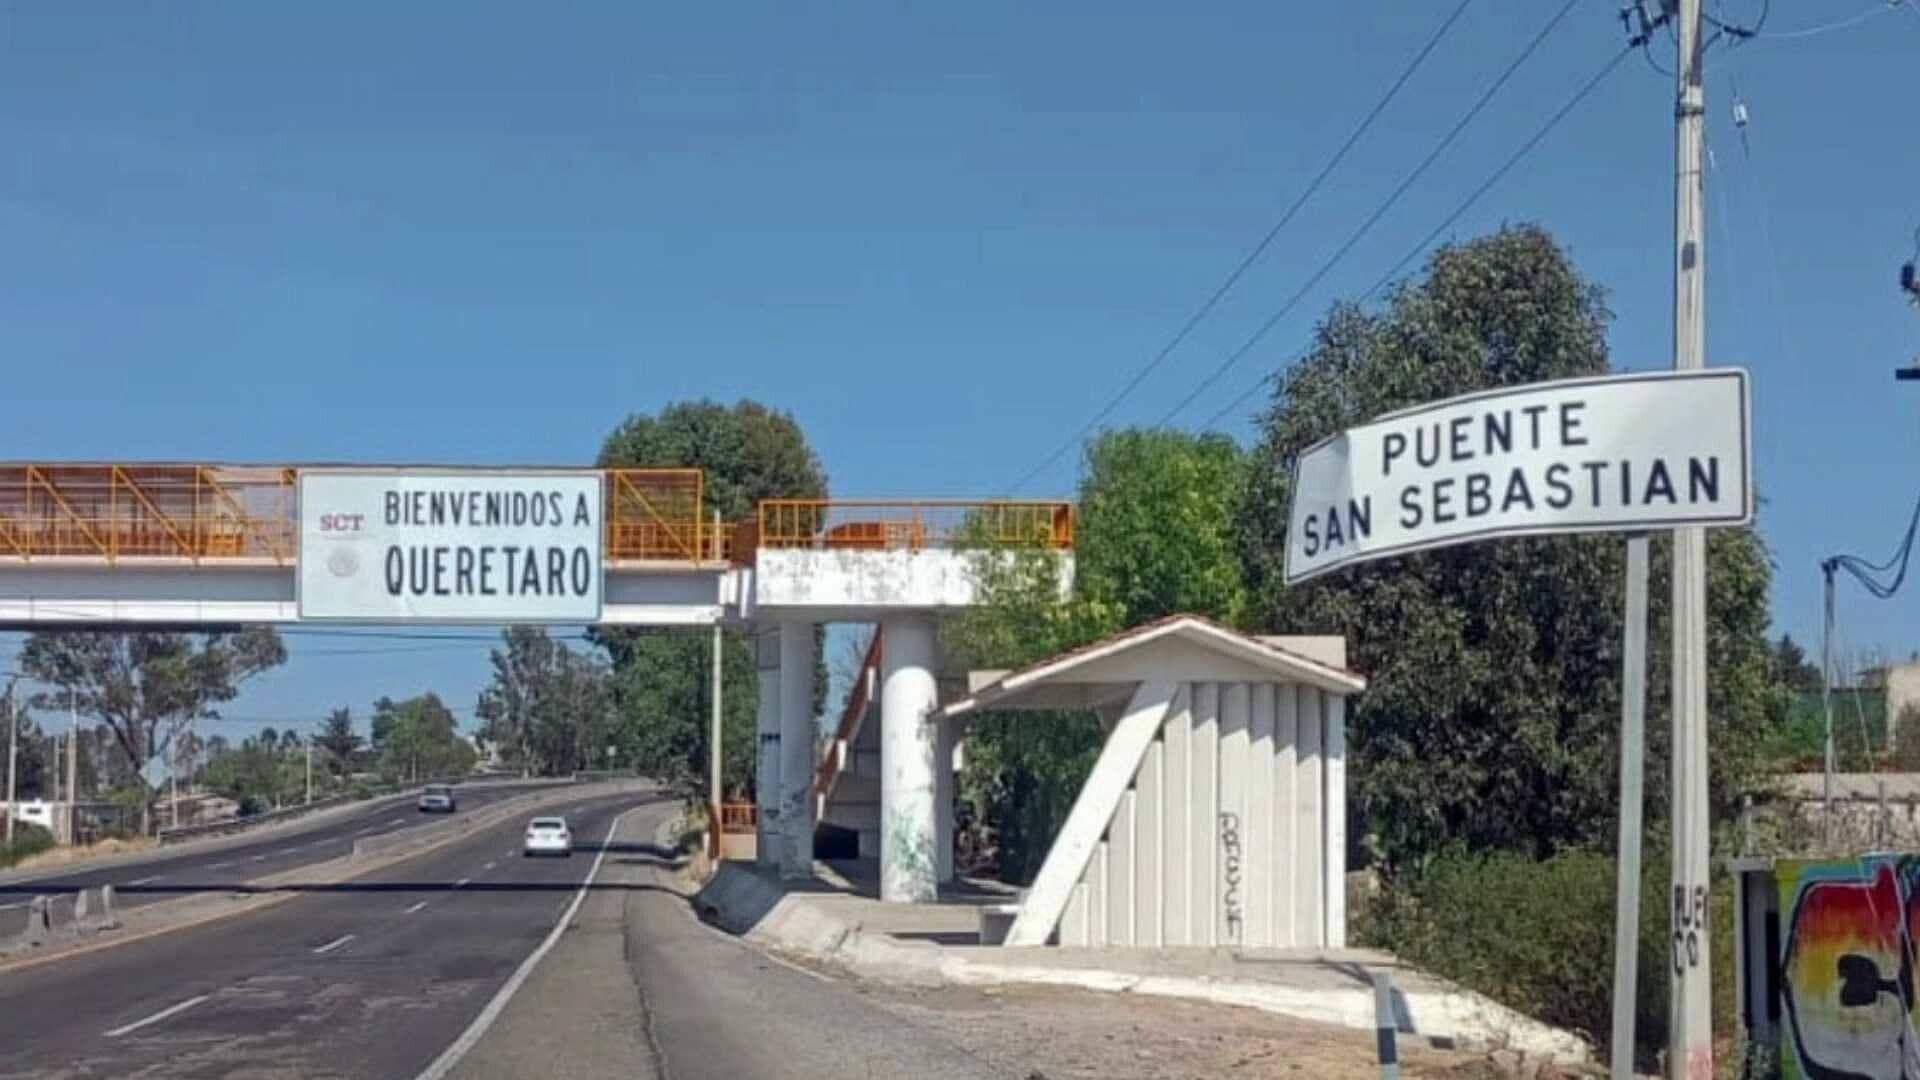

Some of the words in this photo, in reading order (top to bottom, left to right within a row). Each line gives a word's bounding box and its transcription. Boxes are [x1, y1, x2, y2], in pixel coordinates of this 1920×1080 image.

[1382, 401, 1589, 476] PUENTE
[319, 512, 365, 532] SCT
[384, 491, 563, 527] BIENVENIDOS
[573, 492, 590, 527] A
[1303, 495, 1372, 558] SAN
[1400, 456, 1719, 529] SEBASTIAN
[385, 545, 591, 597] QUERETARO
